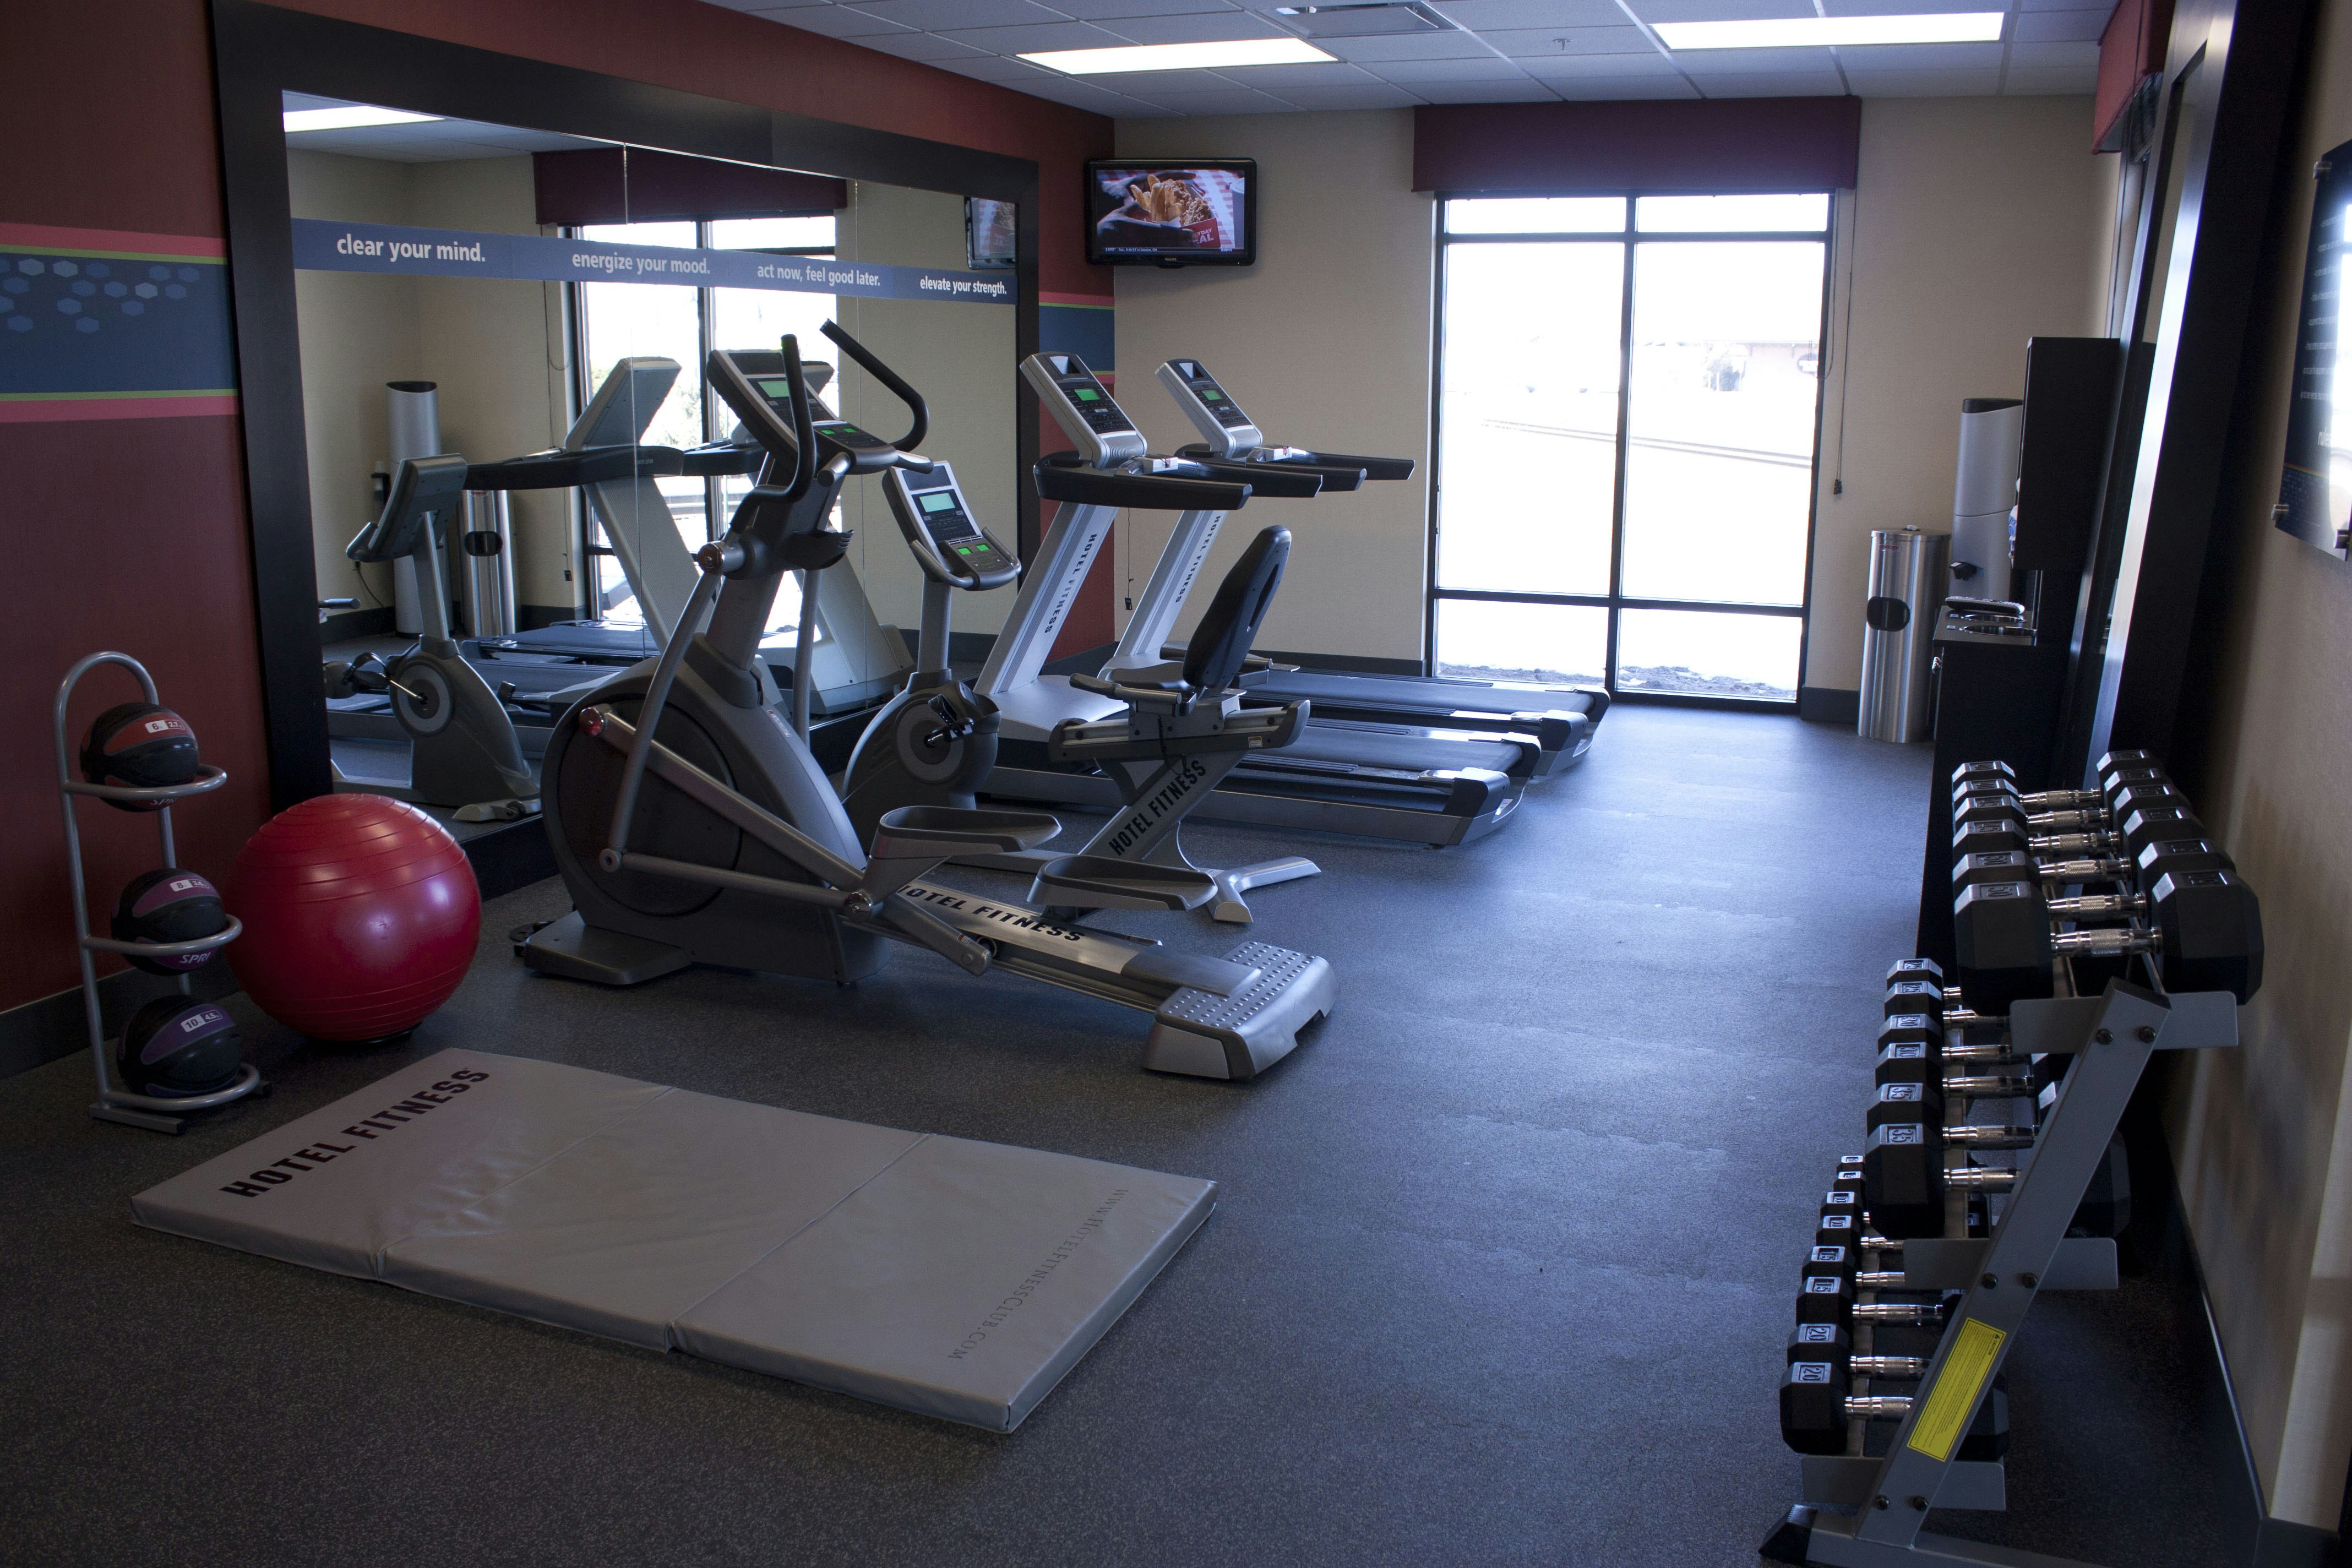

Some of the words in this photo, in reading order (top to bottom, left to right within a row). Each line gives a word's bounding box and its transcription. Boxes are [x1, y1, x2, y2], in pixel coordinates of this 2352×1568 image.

[336, 233, 383, 256] clear
[389, 239, 430, 262] your
[437, 241, 485, 262] mind.
[572, 252, 633, 274] energize
[636, 257, 667, 275] your
[671, 257, 710, 274] mood.
[757, 264, 774, 279] act
[777, 266, 803, 282] now,
[805, 265, 825, 282] feel
[829, 269, 854, 287] good
[856, 270, 880, 286] later.
[920, 275, 951, 291] elevate
[952, 281, 971, 295] your
[973, 281, 1007, 297] strength.
[1200, 515, 1221, 552] HOTEL
[1072, 534, 1097, 575] HOTEL
[1175, 555, 1201, 603] FITNESS
[1044, 579, 1075, 633] FITNESS
[1108, 813, 1153, 856] HOTEL
[1148, 760, 1206, 818] FITNESS
[1988, 886, 2013, 897] 50
[972, 906, 1086, 941] FITNESS
[179, 951, 211, 964] SPRI
[185, 1019, 199, 1028] 10
[1901, 1016, 1919, 1027] 30
[1899, 1047, 1918, 1057] 30
[1891, 1087, 1913, 1099] 35
[219, 1142, 357, 1198] HOTEL
[340, 1069, 490, 1140] FITNESS
[1892, 1129, 1914, 1143] 35
[1815, 1281, 1832, 1292] 15
[1808, 1327, 1827, 1340] 20
[1801, 1367, 1822, 1381] 20
